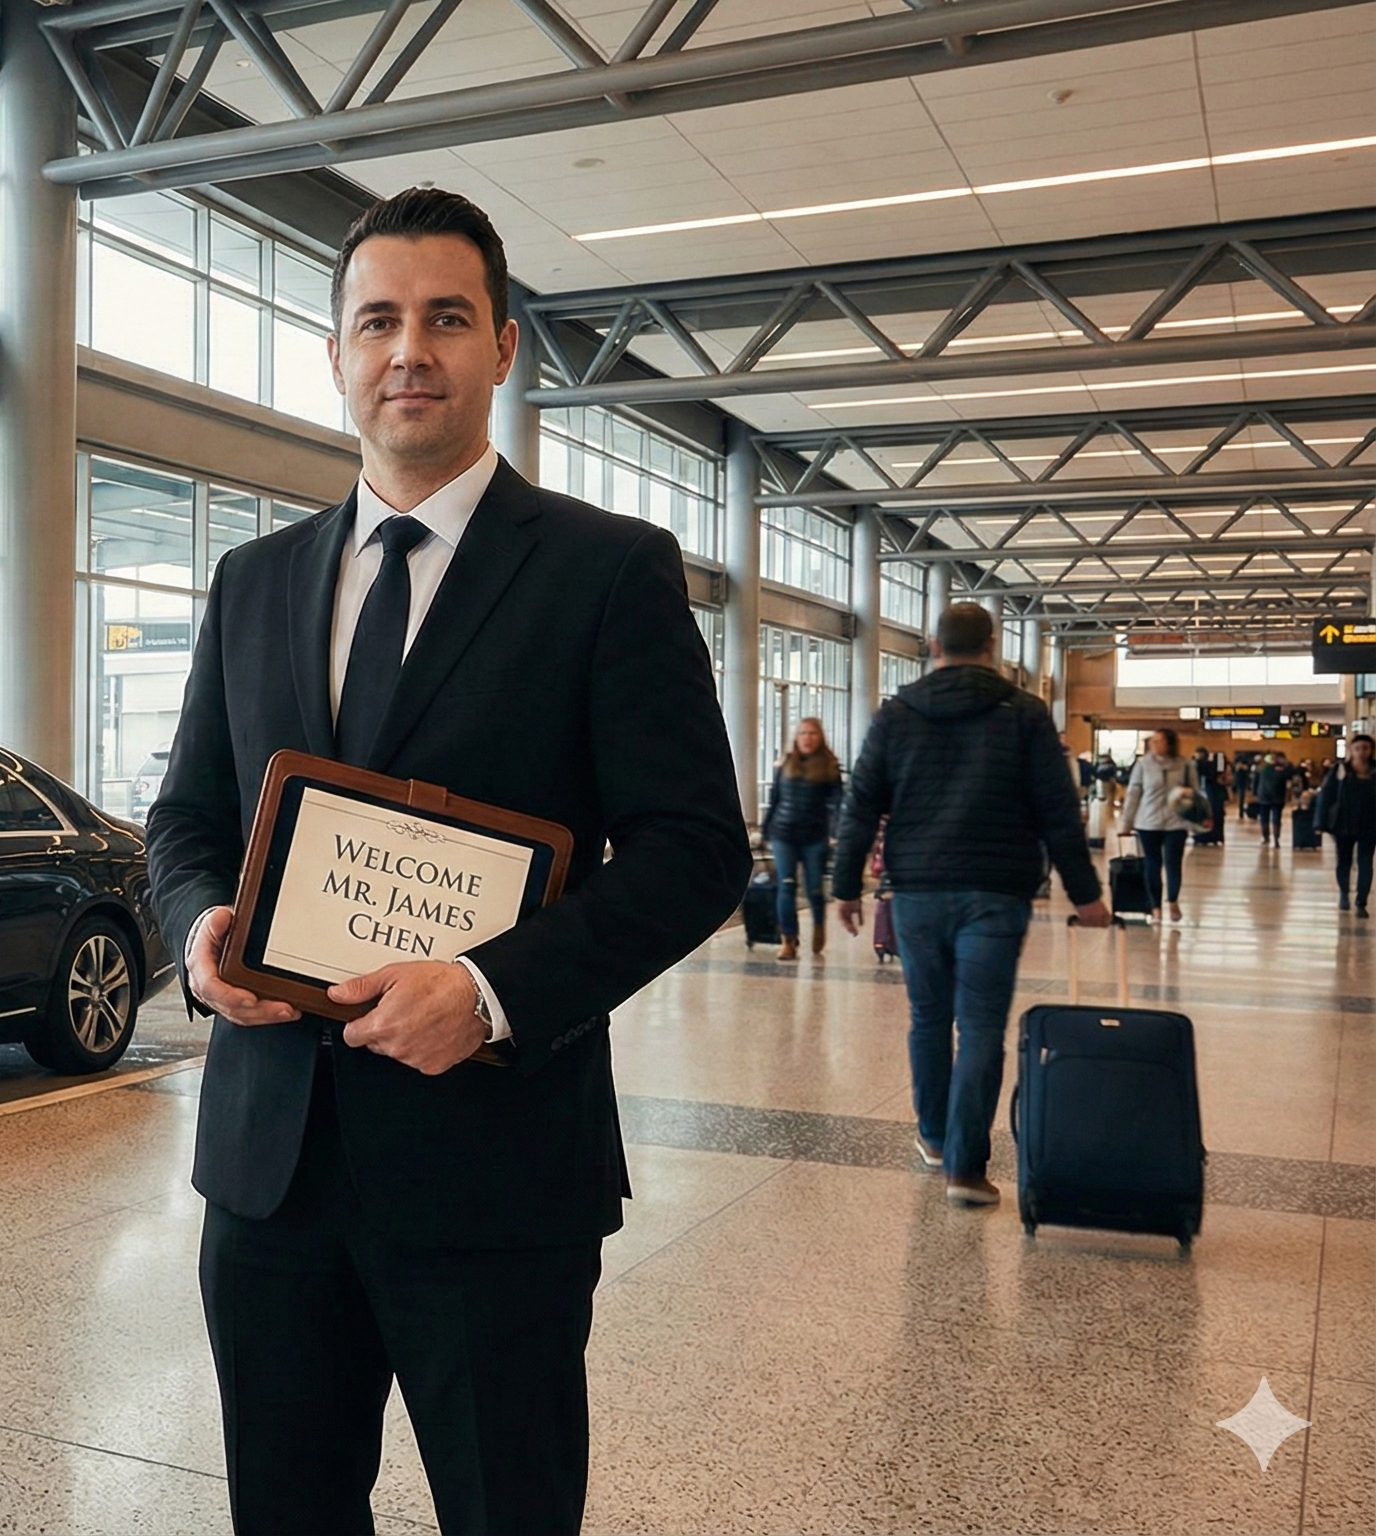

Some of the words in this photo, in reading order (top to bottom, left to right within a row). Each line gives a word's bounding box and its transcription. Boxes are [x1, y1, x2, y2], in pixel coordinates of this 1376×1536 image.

[335, 835, 482, 897] WELCOME
[321, 869, 377, 906] MR.
[383, 886, 476, 932] JAMES
[348, 914, 434, 957] CHEN
